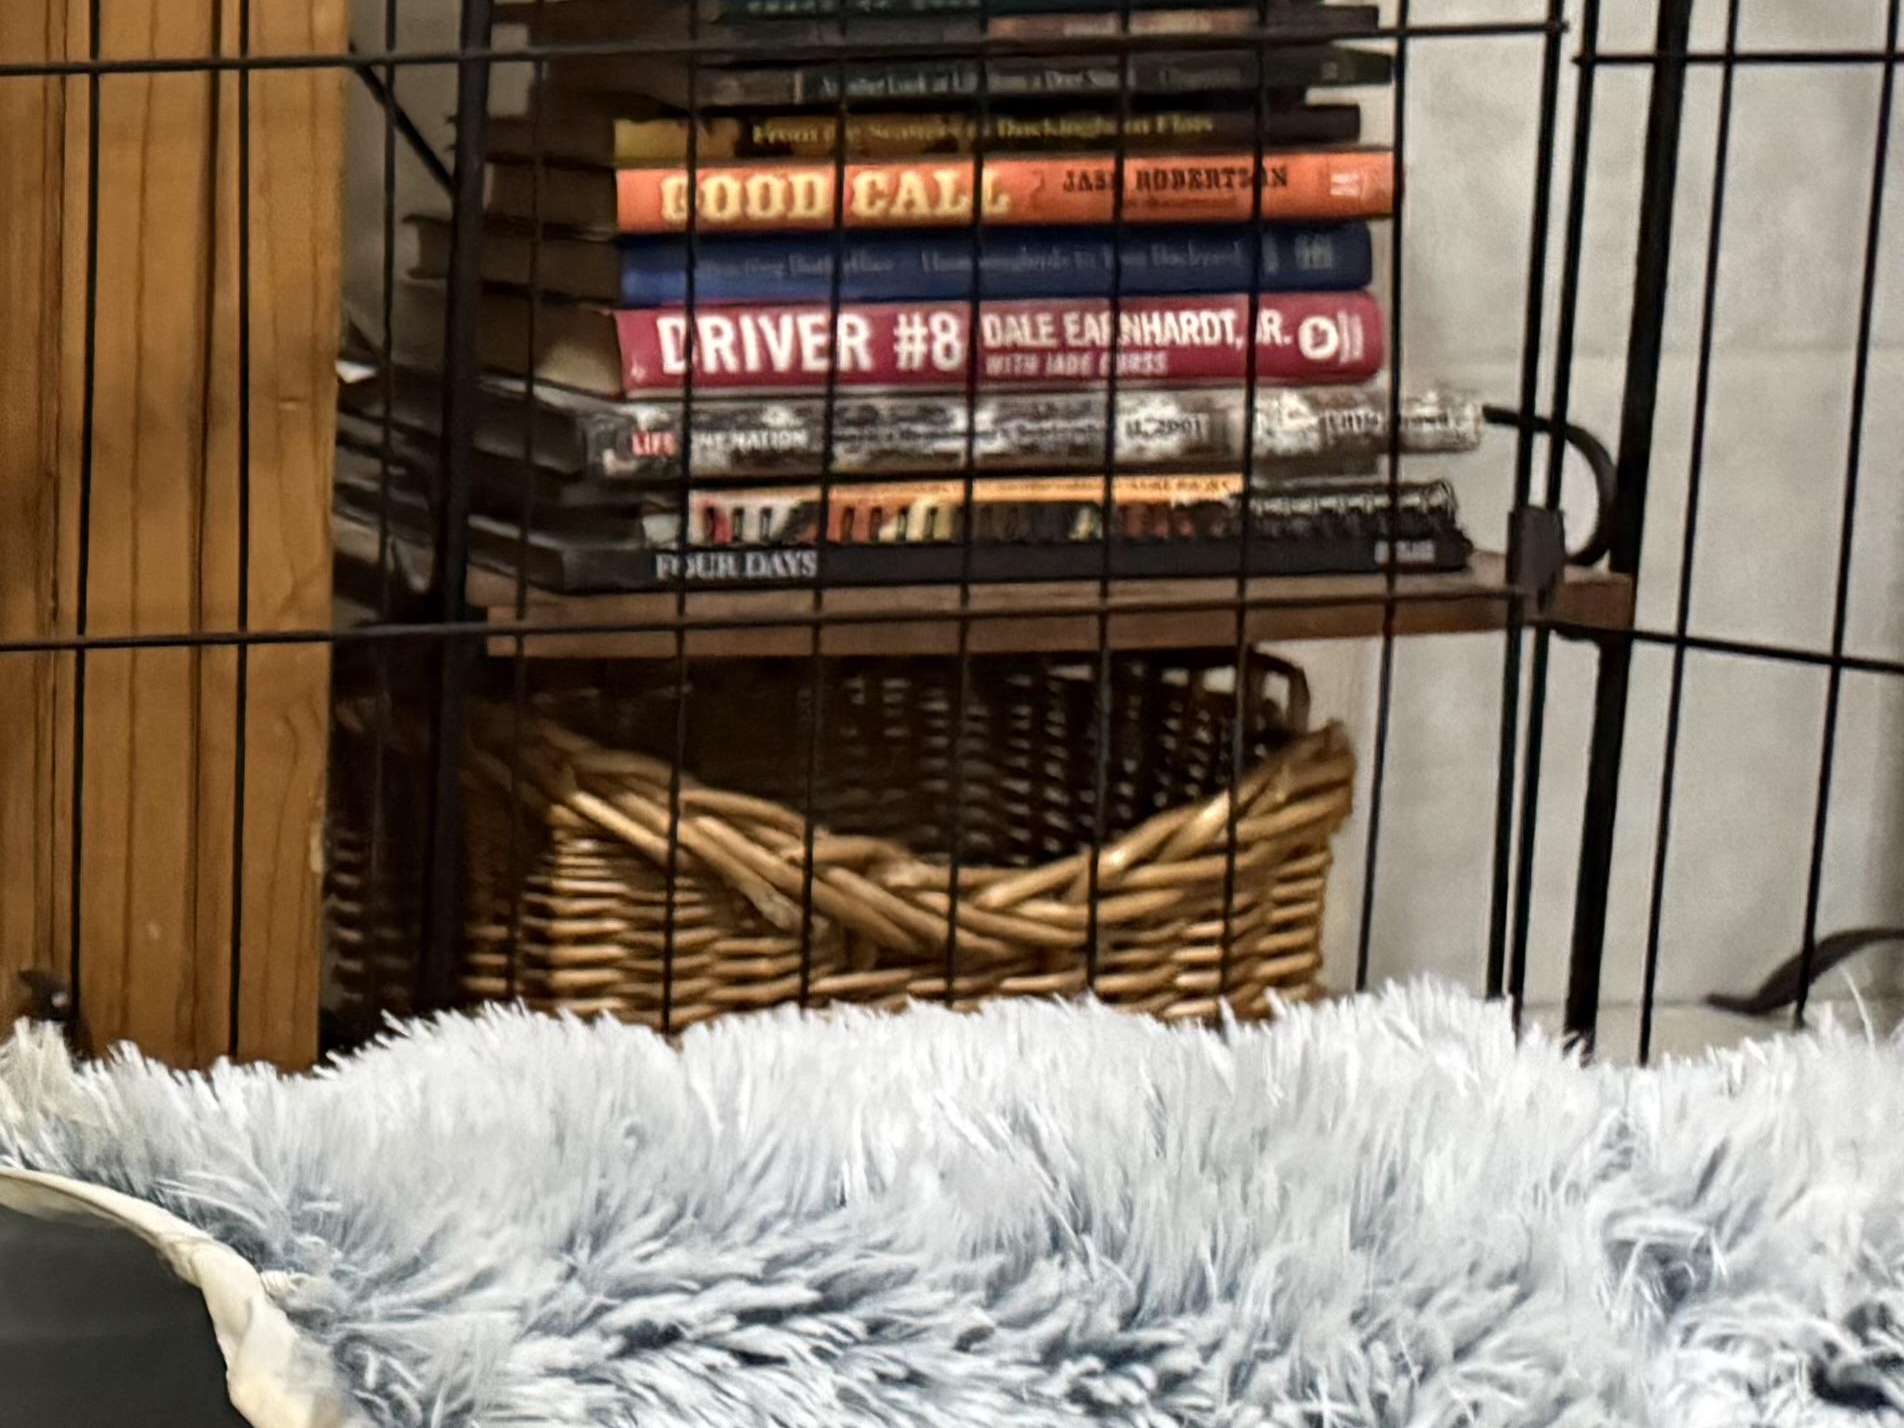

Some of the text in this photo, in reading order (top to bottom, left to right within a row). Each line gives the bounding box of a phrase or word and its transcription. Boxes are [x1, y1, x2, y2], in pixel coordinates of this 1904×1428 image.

[851, 168, 1011, 219] CALL
[657, 311, 965, 375] DRIVER #8
[981, 312, 1058, 349] DALE
[744, 549, 817, 579] DAYS
